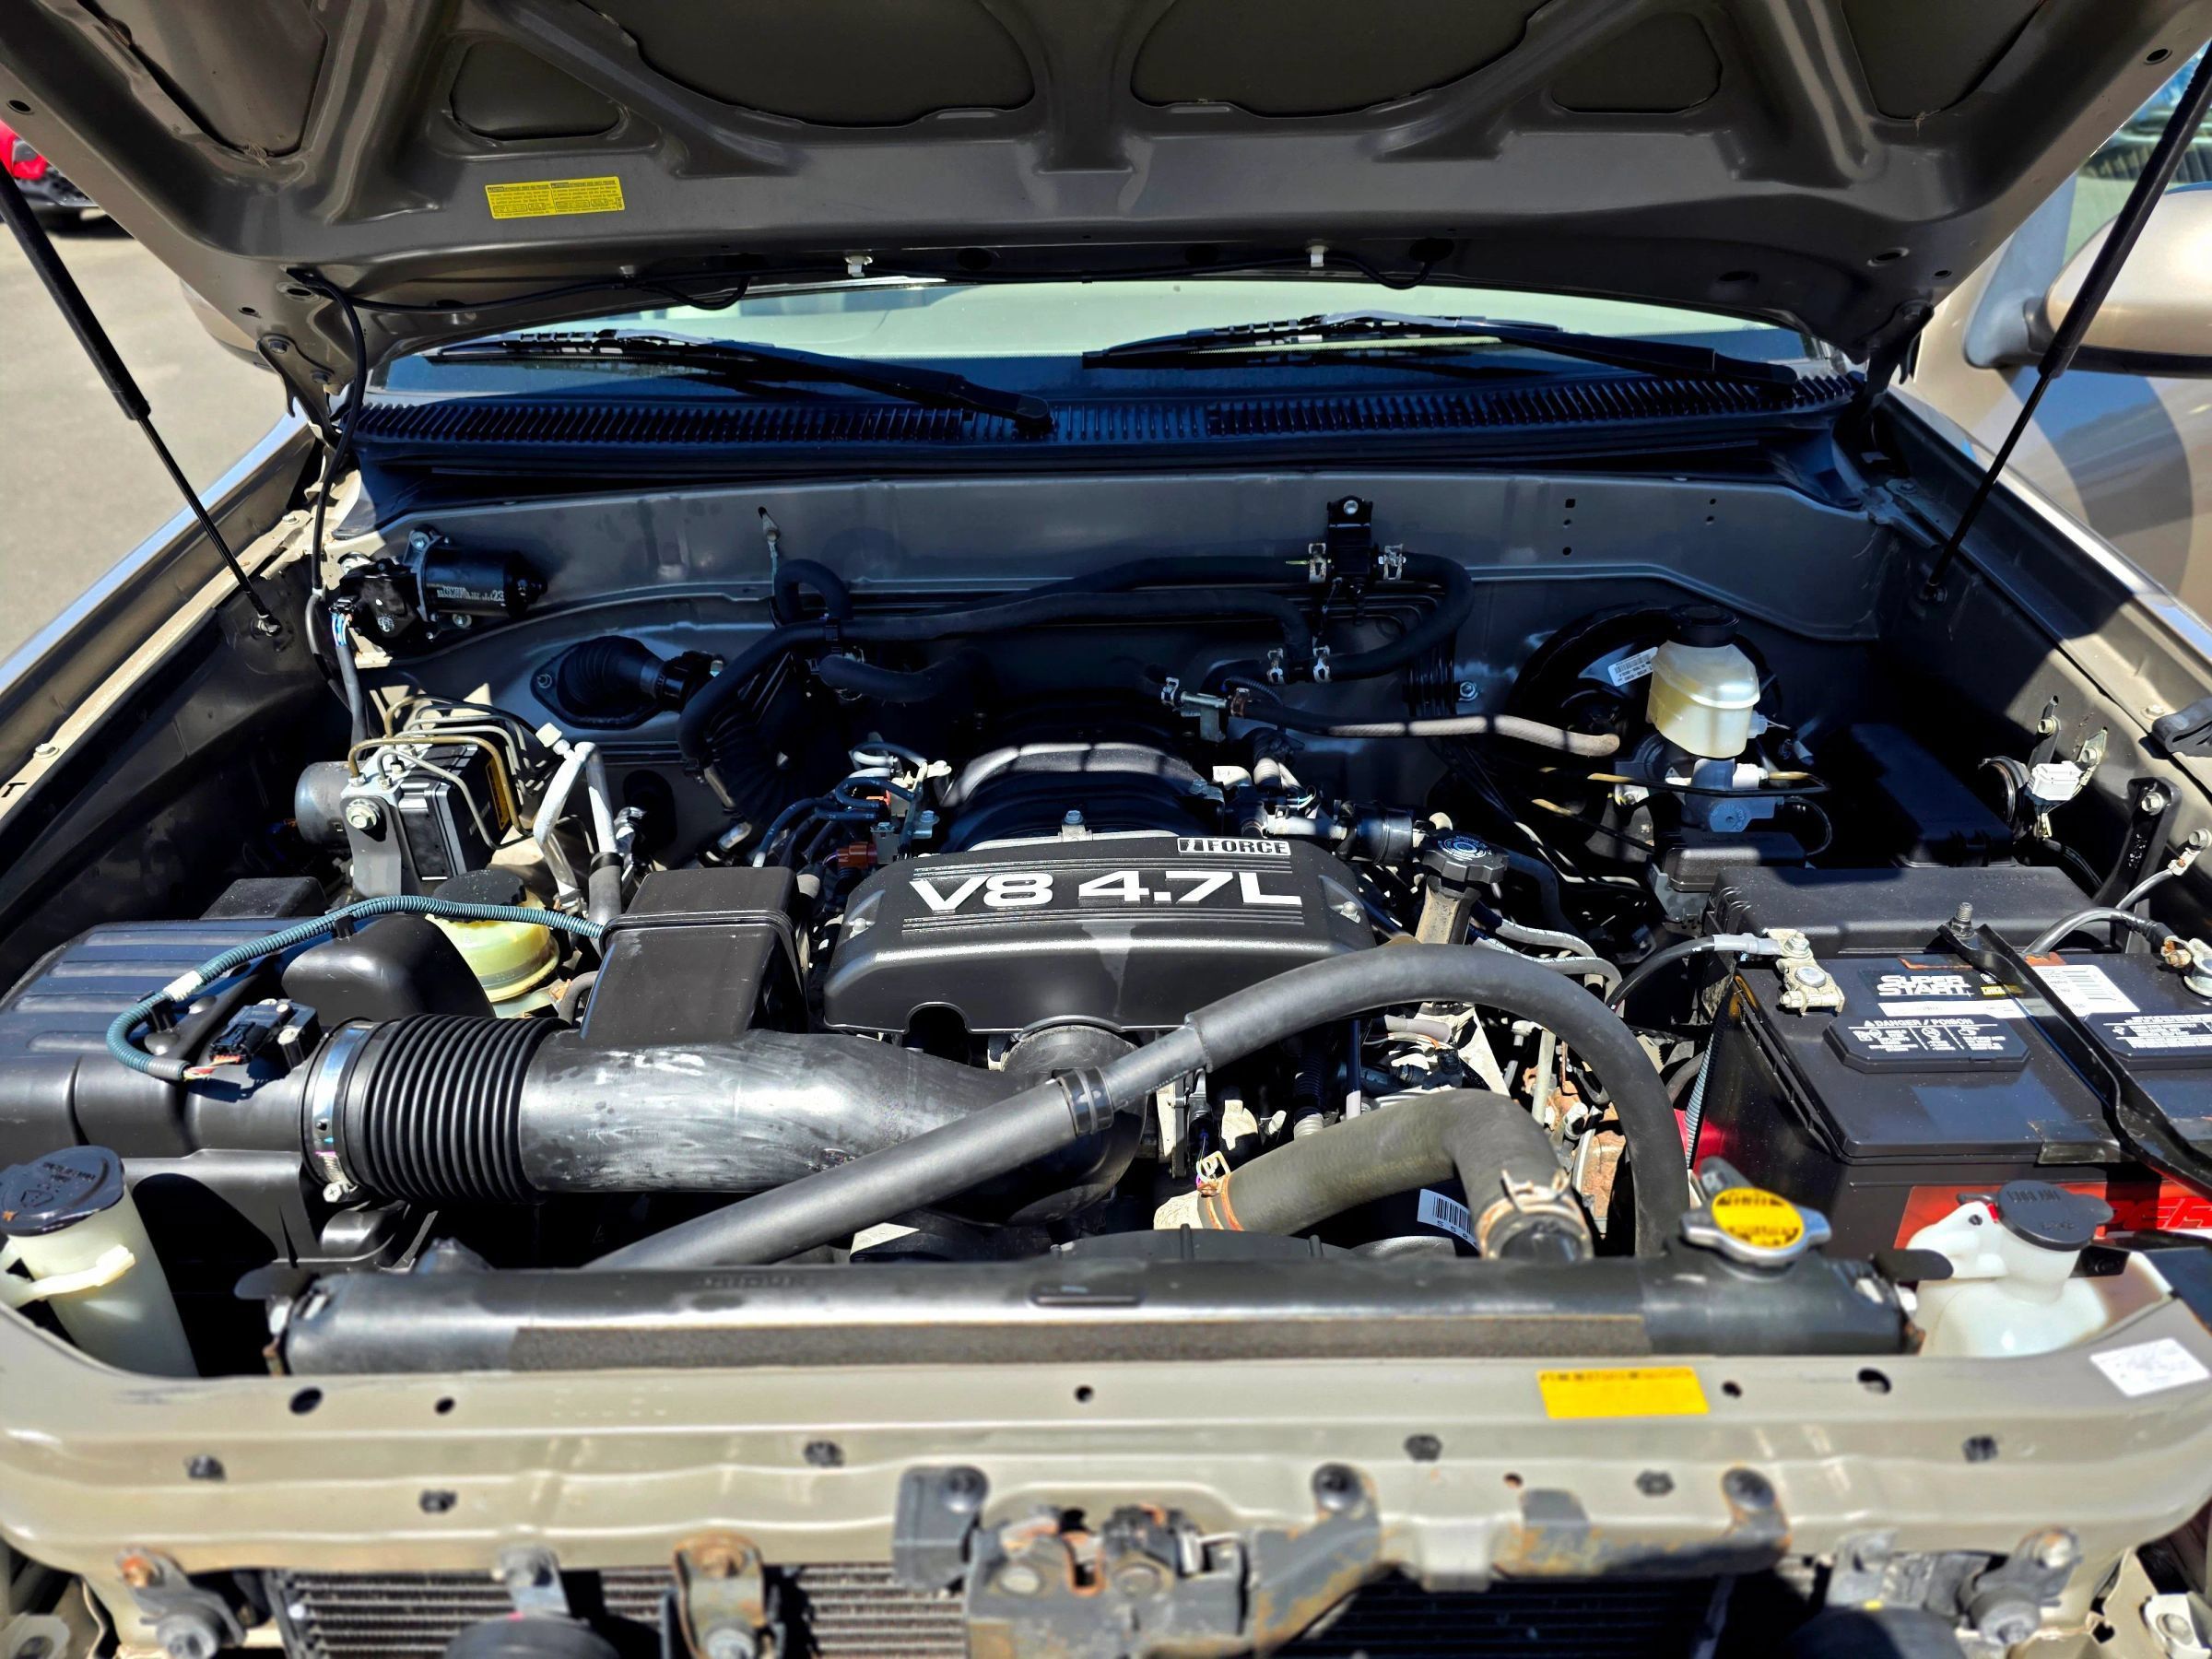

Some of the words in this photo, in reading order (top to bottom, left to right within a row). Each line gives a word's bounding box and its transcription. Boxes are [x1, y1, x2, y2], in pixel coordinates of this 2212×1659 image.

[909, 874, 1053, 912] V8
[1078, 870, 1302, 906] 4.7L
[1881, 975, 1965, 985] SUPER
[1877, 982, 1971, 996] START
